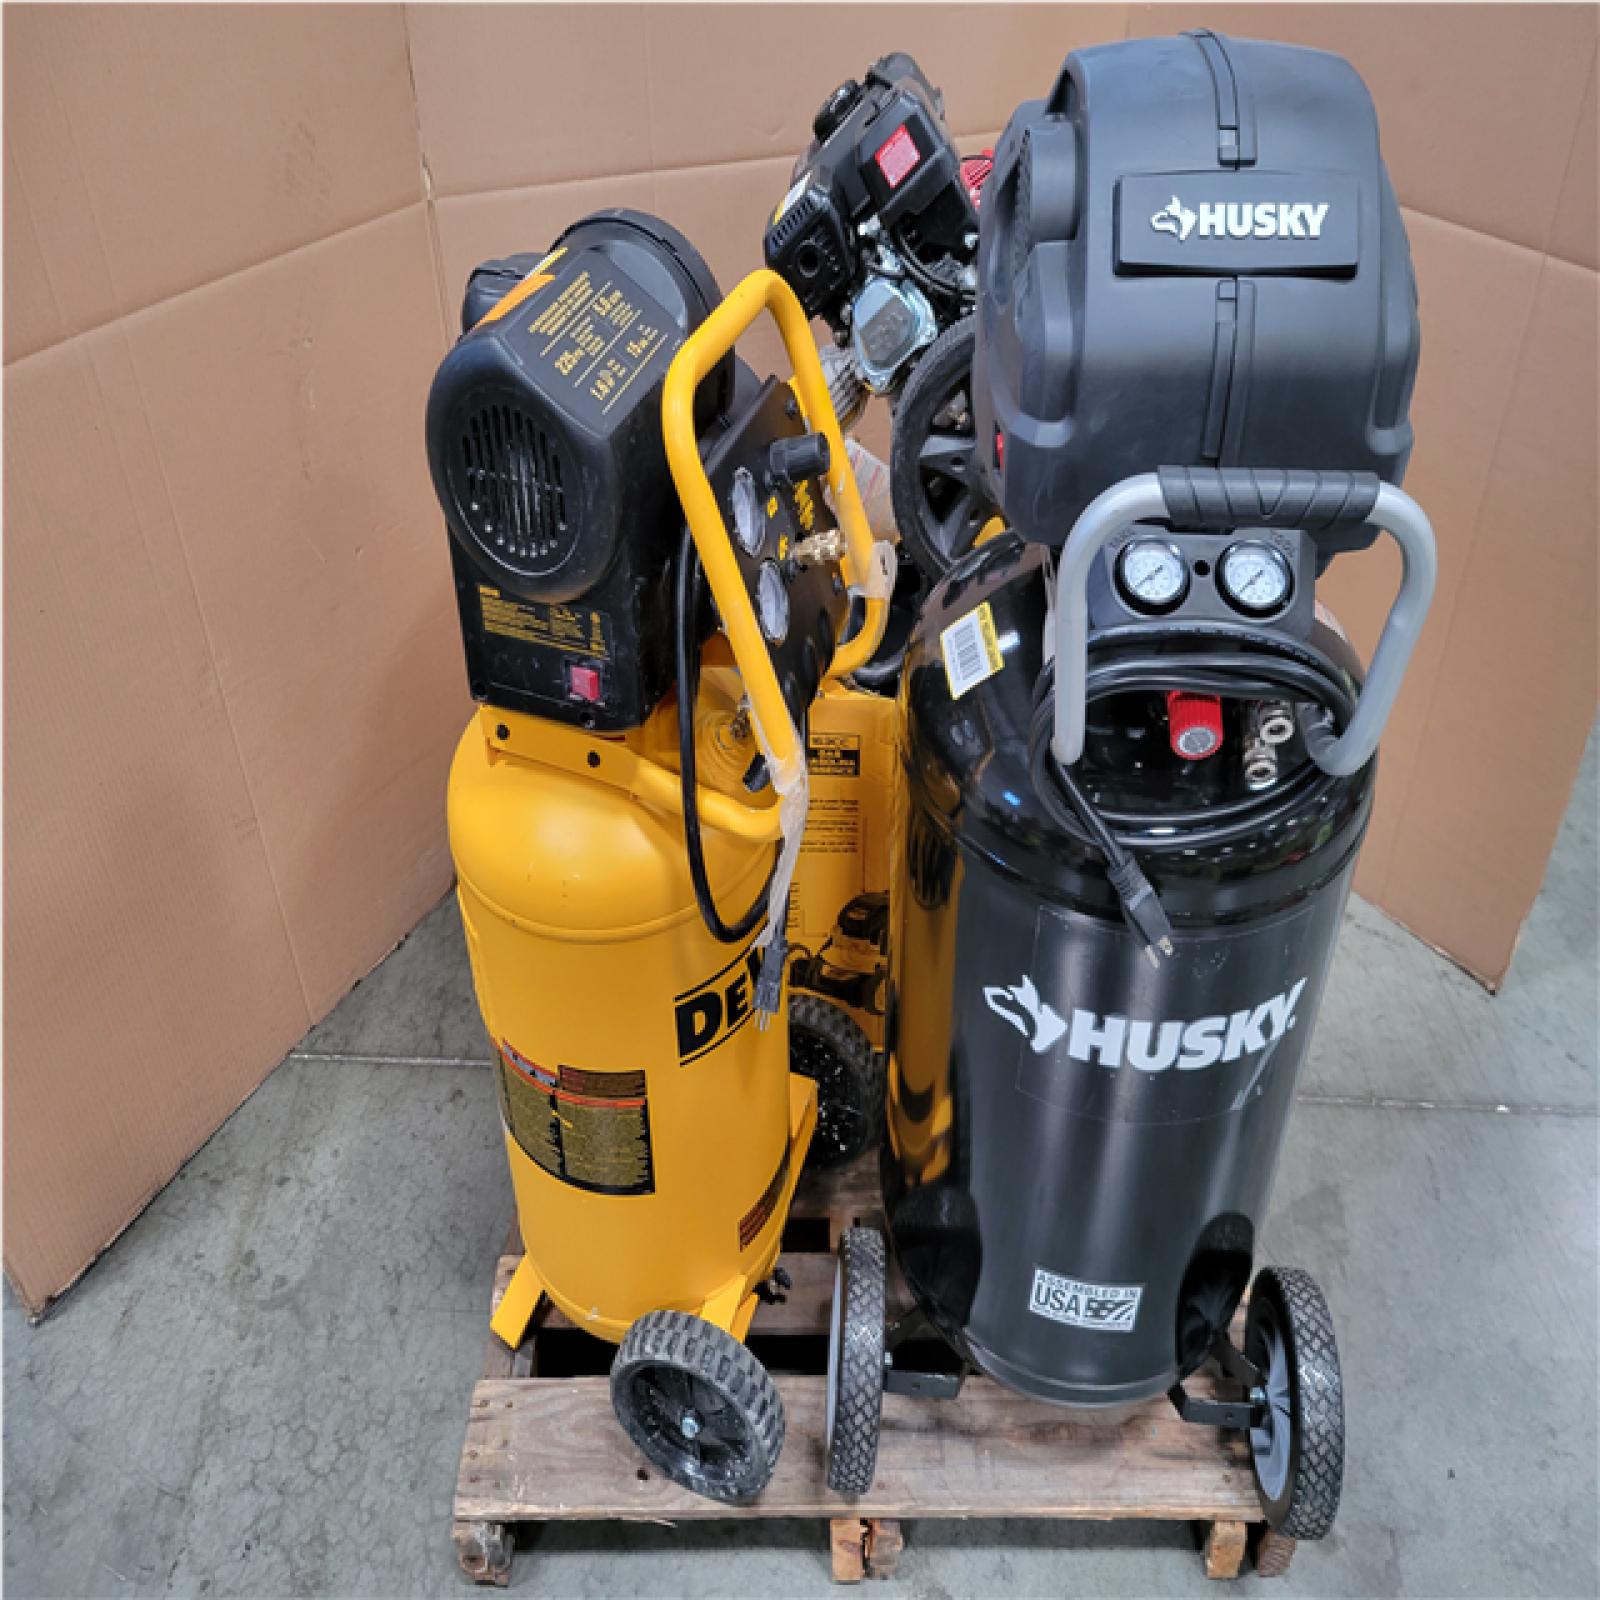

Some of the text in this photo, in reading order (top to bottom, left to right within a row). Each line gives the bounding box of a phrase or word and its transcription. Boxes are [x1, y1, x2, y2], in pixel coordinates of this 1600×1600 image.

[1198, 201, 1329, 239] HUSKY
[1067, 976, 1308, 1073] HUSKY
[1035, 1282, 1079, 1315] USA
[1036, 1272, 1137, 1299] ASSEMBLED IN
